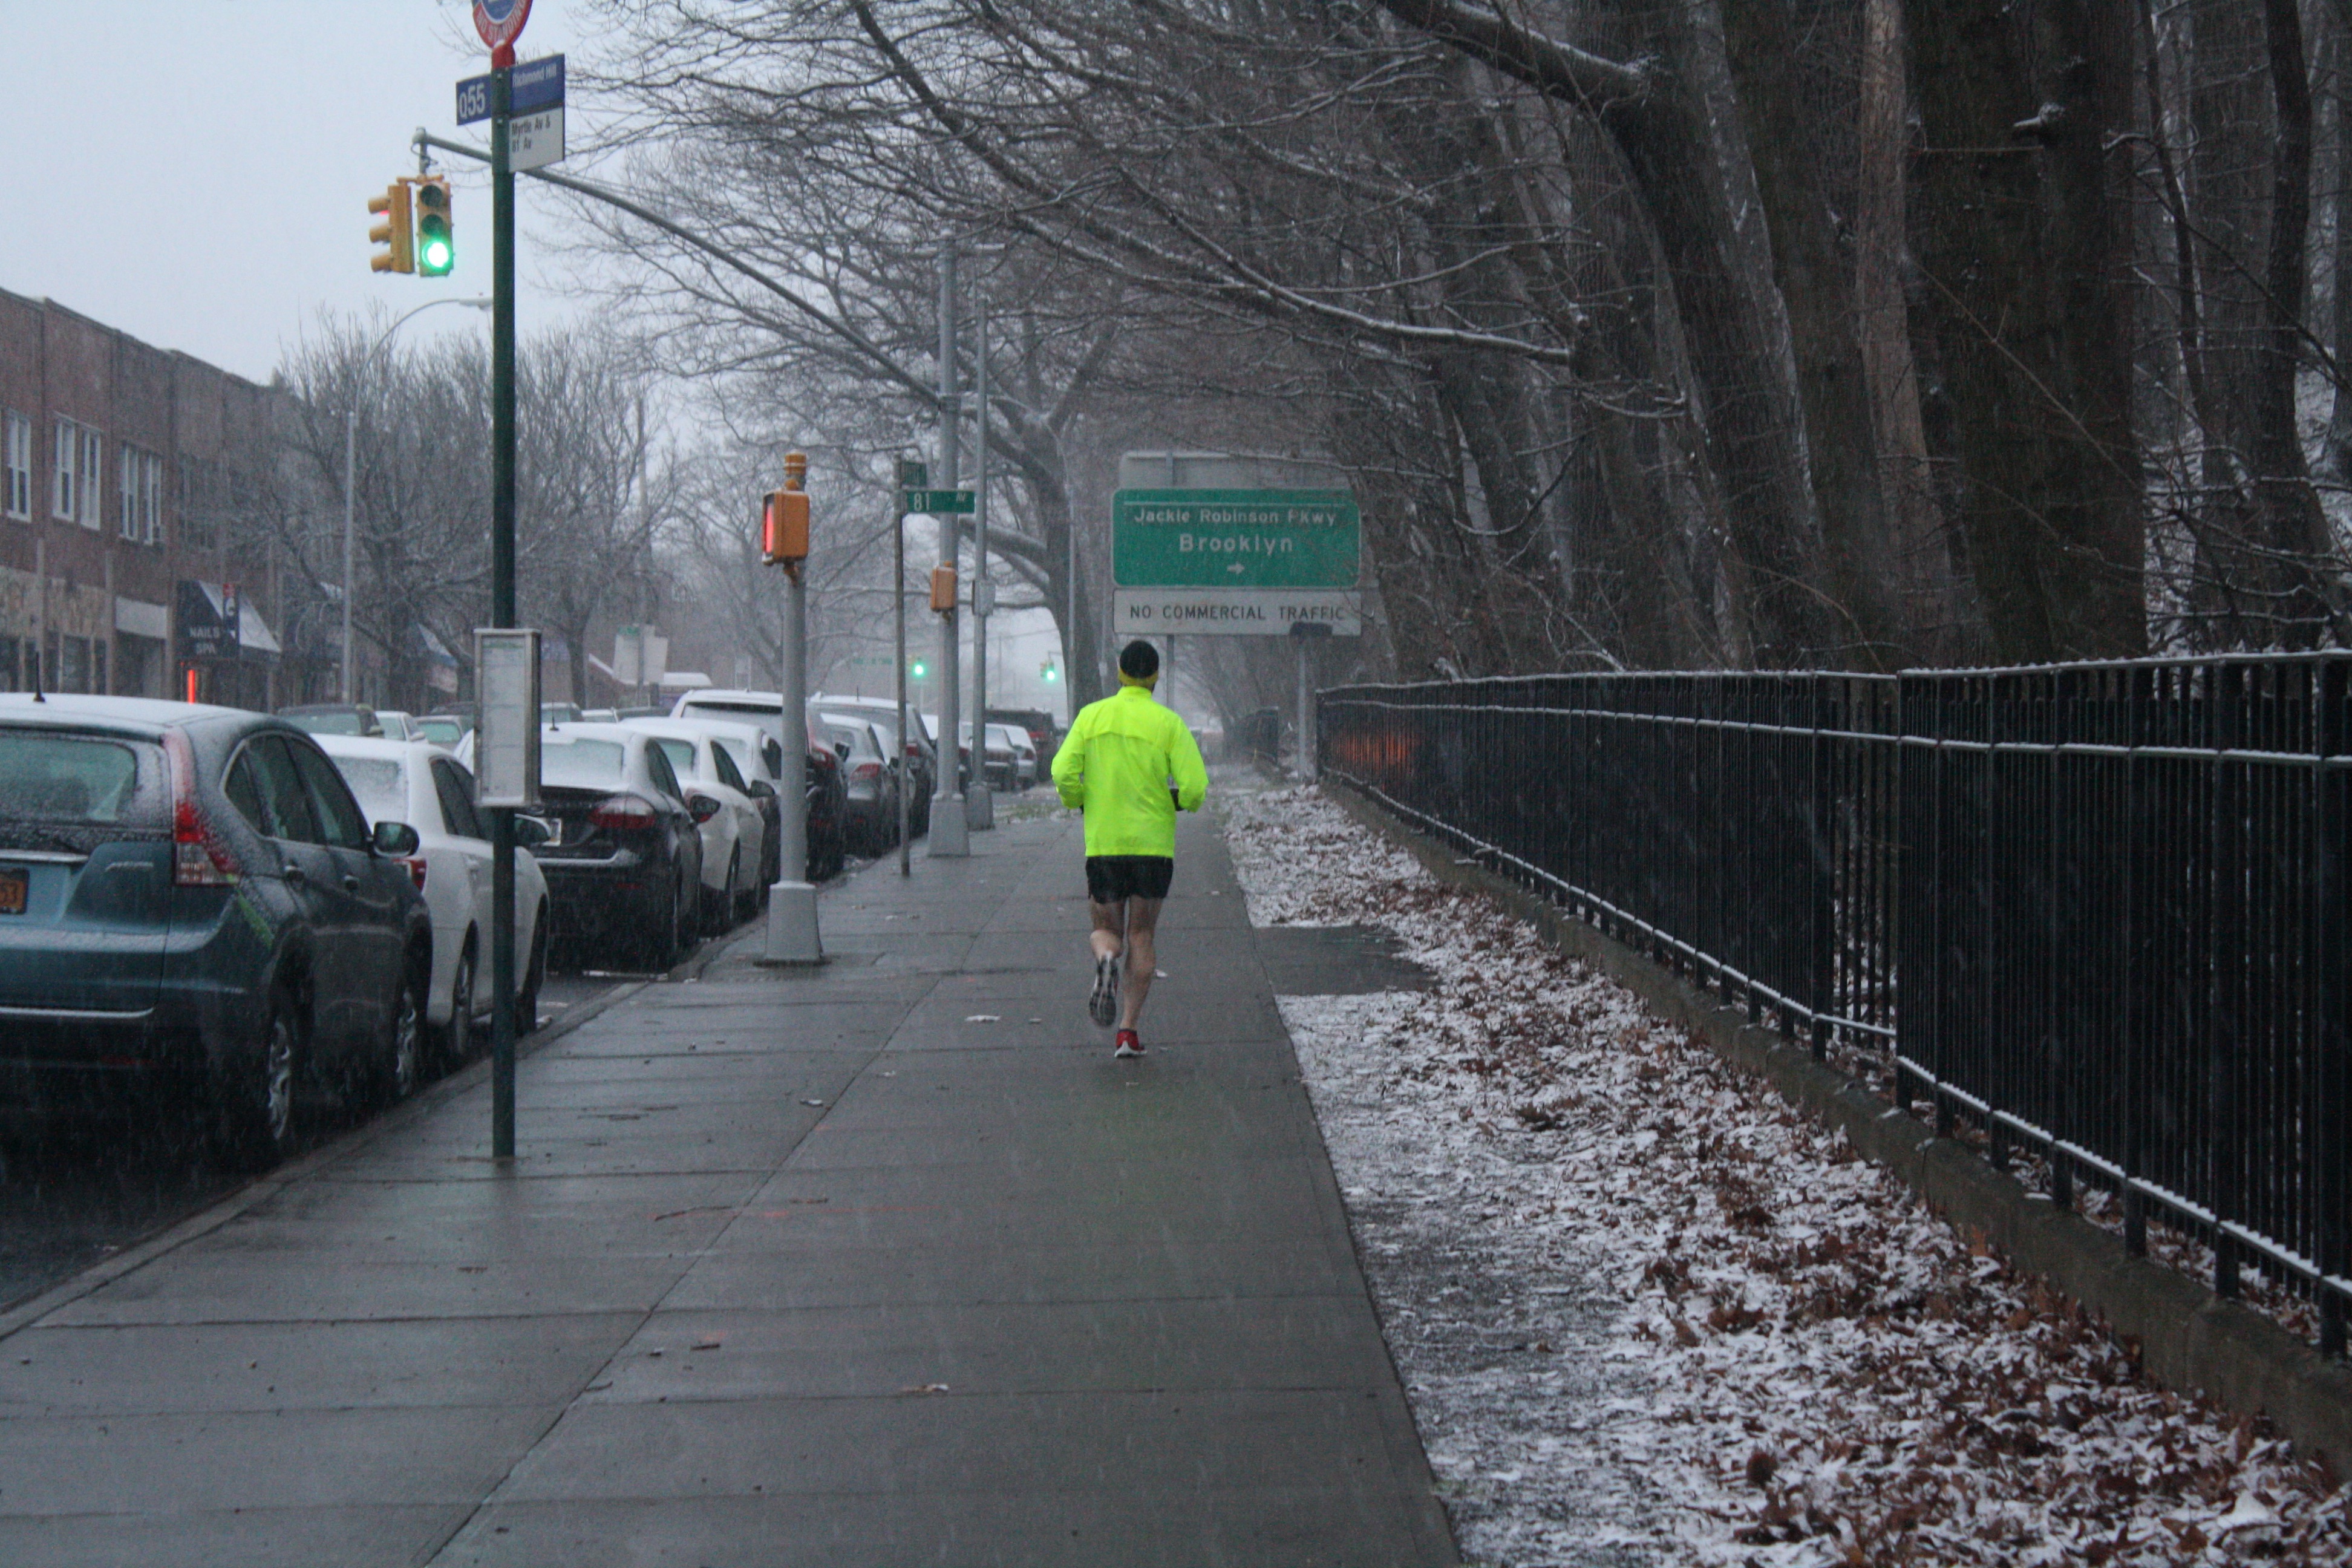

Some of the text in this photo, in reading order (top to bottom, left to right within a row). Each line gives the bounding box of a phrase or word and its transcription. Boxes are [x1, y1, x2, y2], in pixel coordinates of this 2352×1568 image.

[459, 83, 486, 119] Q55
[512, 119, 532, 139] Myrtle
[534, 116, 543, 131] Av
[523, 137, 532, 150] Av
[913, 492, 967, 512] 81 AV
[1134, 508, 1191, 523] Jackie
[1200, 508, 1279, 523] Robinson
[1179, 533, 1293, 556] Brooklyn
[1129, 605, 1345, 621] NO COMMERCIAL TRAFFIC
[189, 626, 221, 639] NAILS
